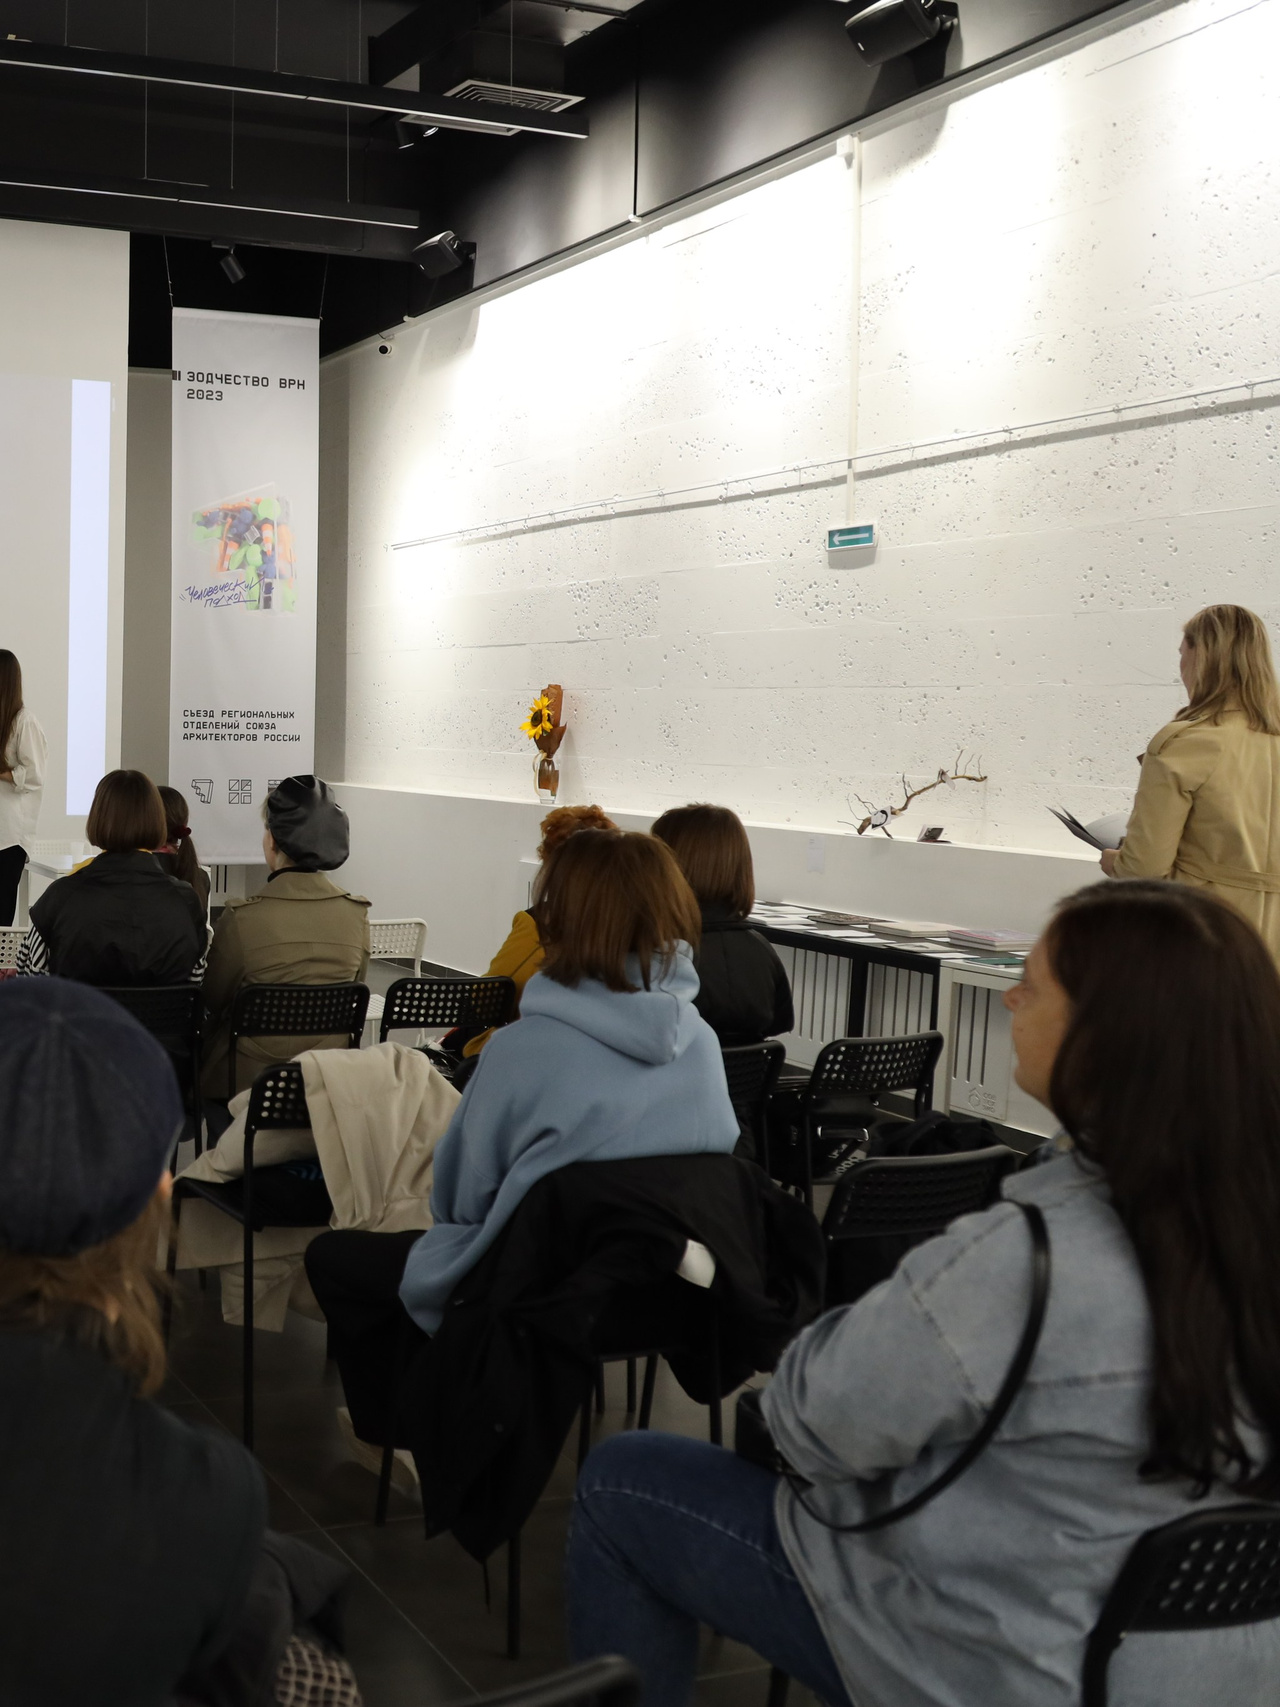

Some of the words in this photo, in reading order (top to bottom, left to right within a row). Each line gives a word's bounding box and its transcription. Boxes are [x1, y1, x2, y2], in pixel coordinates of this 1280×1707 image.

[186, 371, 270, 388] ЗОДЧЕСТВО
[279, 377, 306, 391] ВРН
[186, 388, 224, 402] 2023
[183, 709, 215, 719] СЪЕЗД
[220, 709, 295, 719] РЕГИОНАЛЬНЫХ
[182, 720, 240, 730] ОТДЕЛЕНИЙ
[245, 721, 277, 731] СОЮЗА
[182, 732, 258, 742] АРХИТЕКТОРОВ
[263, 733, 301, 742] РОССИИ
